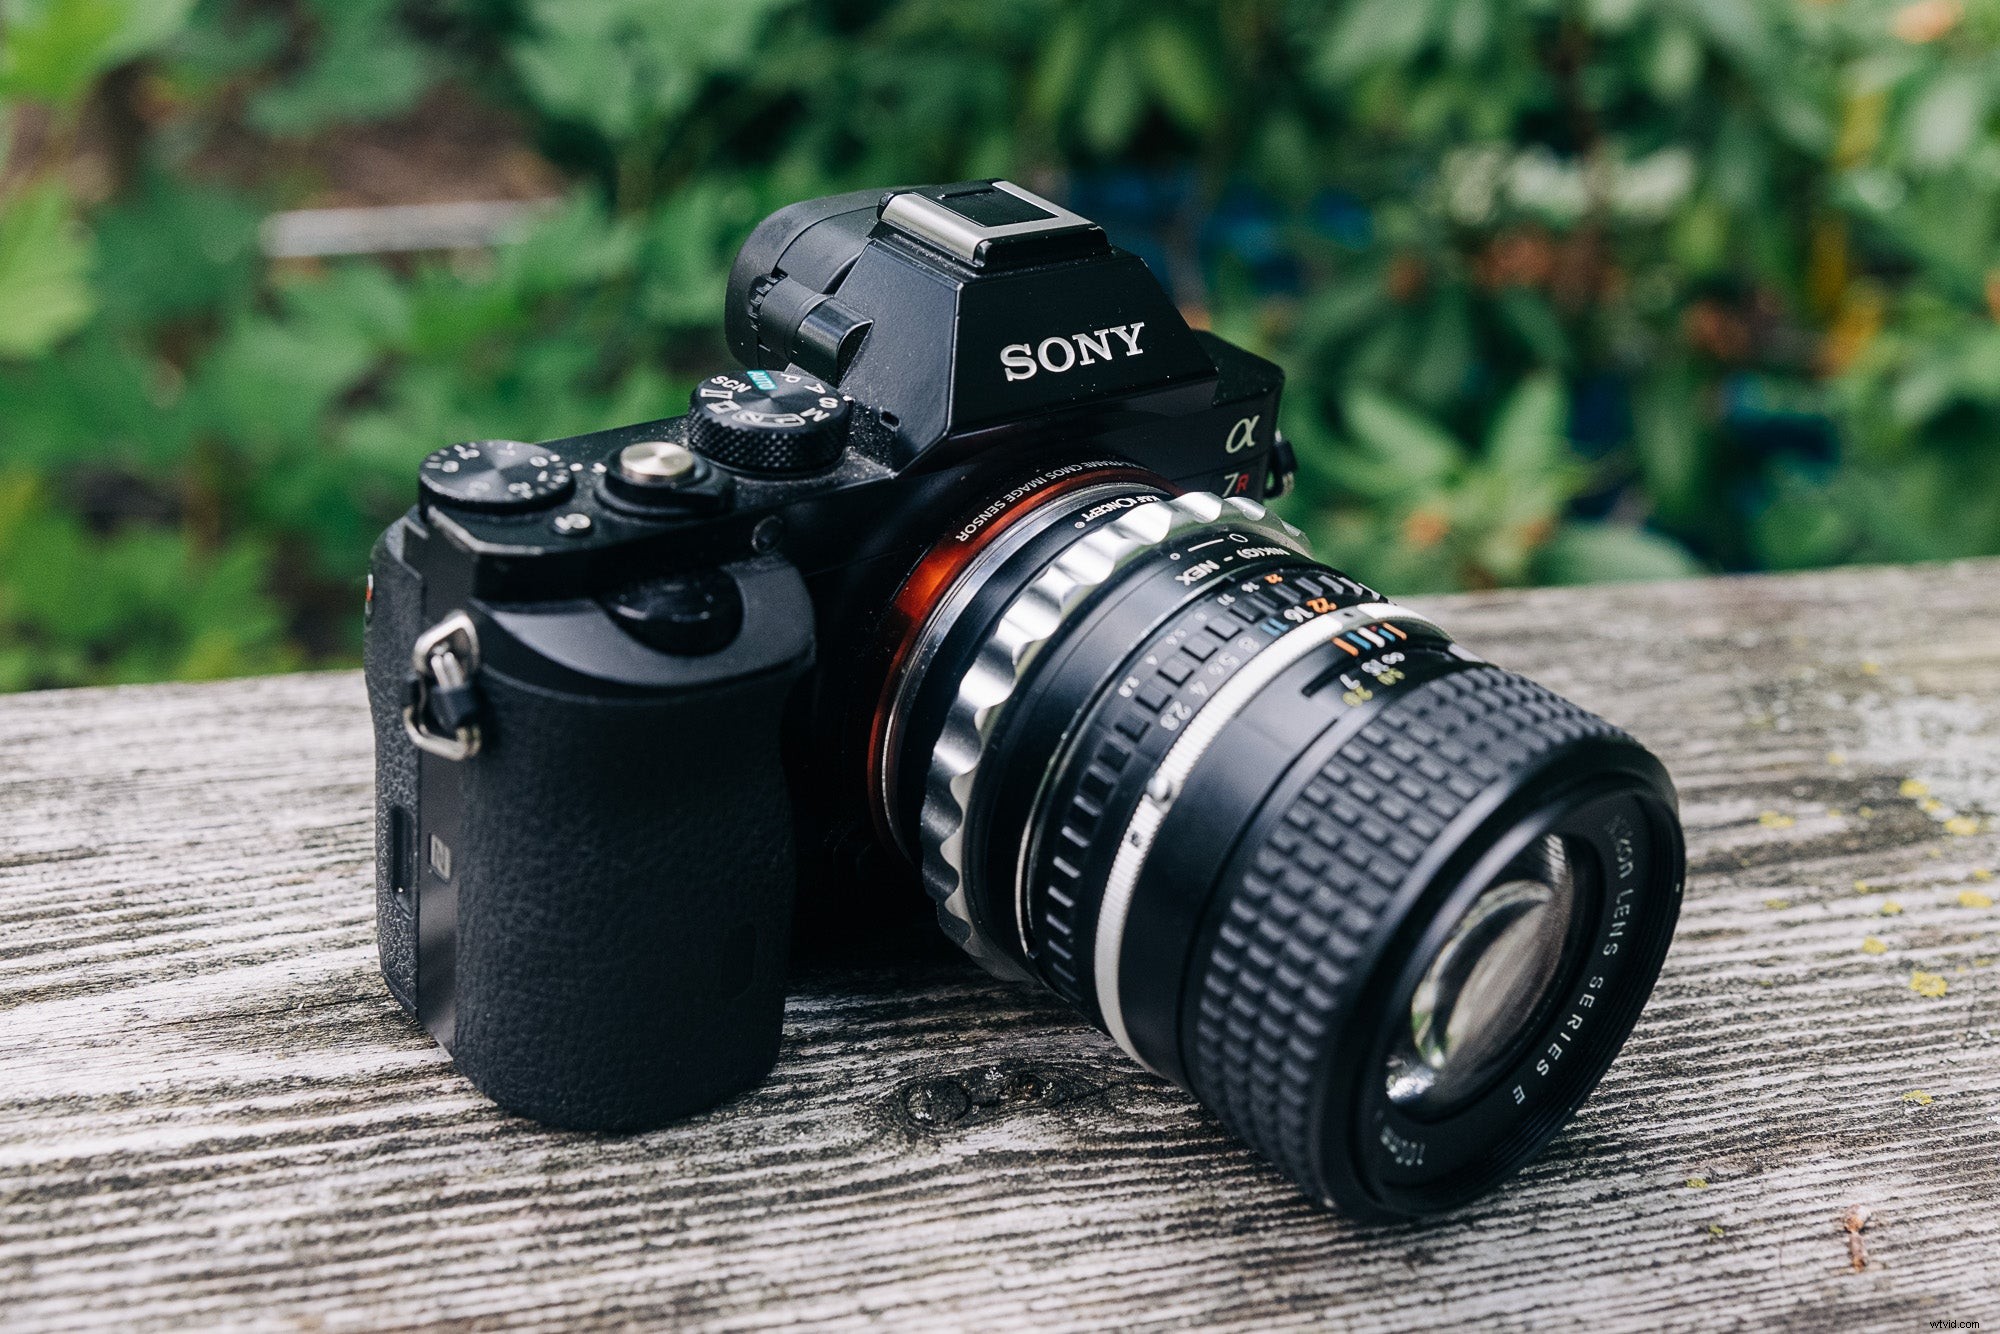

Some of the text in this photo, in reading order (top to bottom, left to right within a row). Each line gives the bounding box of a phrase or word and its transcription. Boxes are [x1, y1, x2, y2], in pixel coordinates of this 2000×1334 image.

[1000, 321, 1145, 382] SONY
[710, 375, 752, 393] SCN
[747, 370, 777, 390] AUTO
[804, 383, 827, 394] A
[800, 407, 831, 423] M
[1044, 464, 1084, 481] CMOS
[1008, 476, 1048, 503] IMAGE
[1222, 472, 1250, 498] 7R
[955, 501, 1006, 542] SENSOR
[1175, 559, 1220, 586] NEX
[1283, 605, 1315, 623] 16
[1602, 888, 1635, 957] LENS
[1536, 975, 1605, 1077] SERIES
[1512, 1084, 1526, 1105] E
